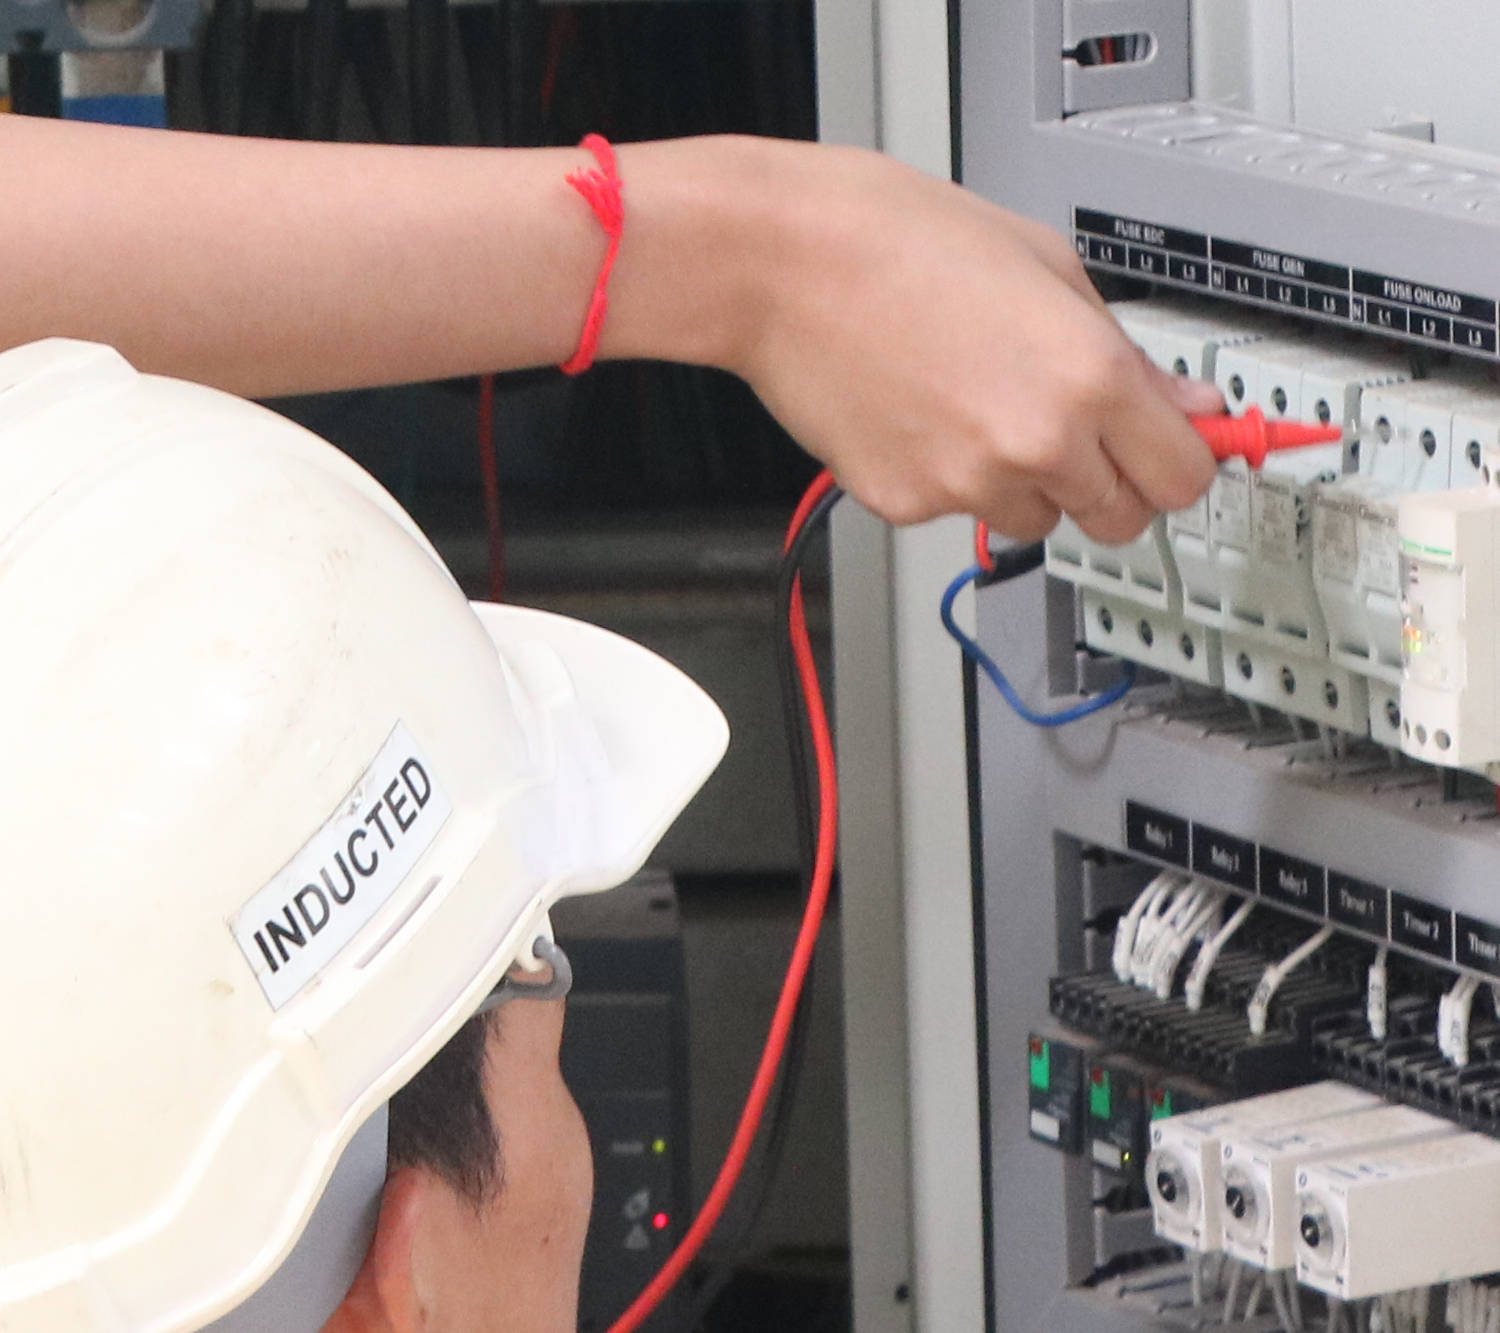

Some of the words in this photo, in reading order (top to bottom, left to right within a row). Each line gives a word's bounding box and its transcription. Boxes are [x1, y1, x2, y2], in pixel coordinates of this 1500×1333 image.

[1114, 219, 1142, 239] FUSE
[1100, 246, 1113, 261] L1
[1140, 254, 1154, 272] L2
[1252, 250, 1280, 273] FUSE
[1236, 276, 1249, 293] L1
[1279, 285, 1292, 303] L2
[1383, 280, 1413, 302] FUSE
[1414, 286, 1462, 312] ONLOAD
[1378, 309, 1392, 324] L1
[1422, 318, 1436, 337] L2
[252, 756, 432, 975] INDUCTED
